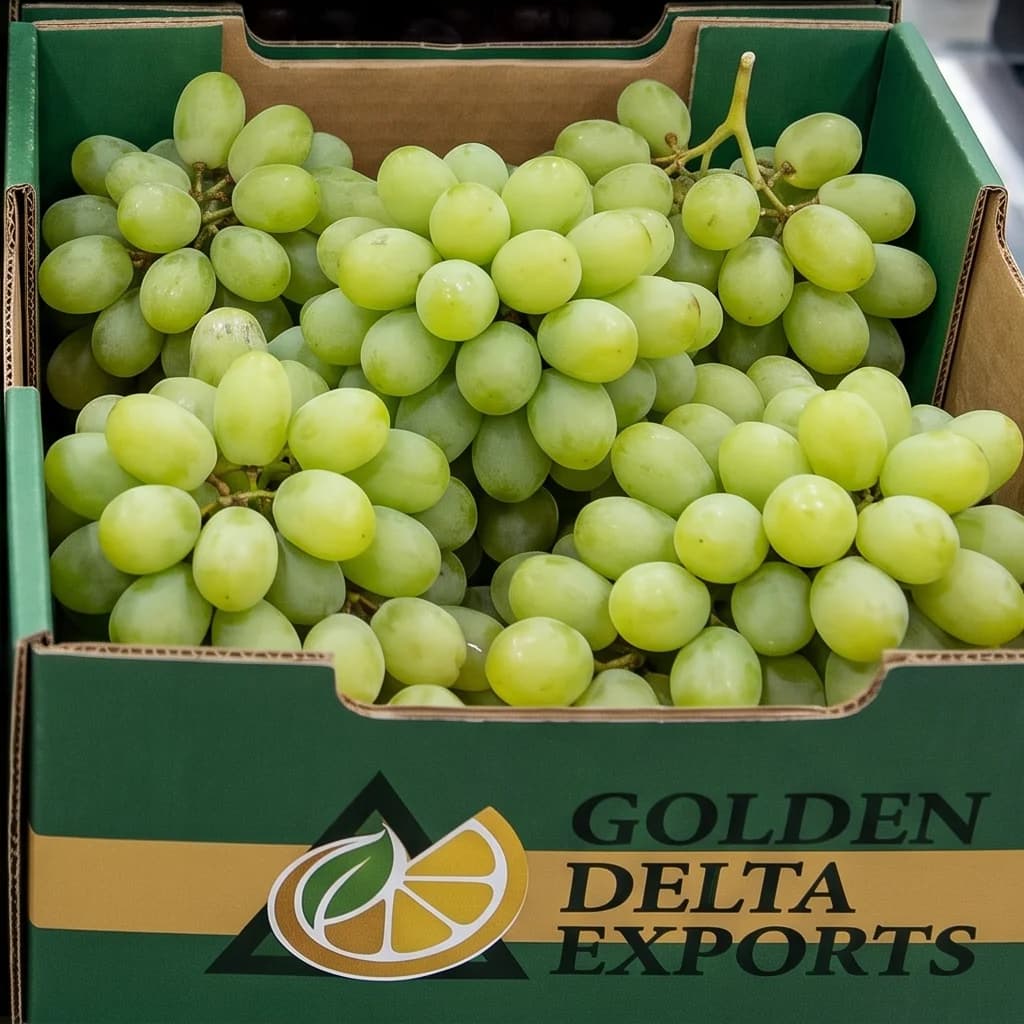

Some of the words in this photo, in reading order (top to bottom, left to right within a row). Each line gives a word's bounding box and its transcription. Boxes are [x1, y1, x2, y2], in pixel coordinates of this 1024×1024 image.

[570, 791, 993, 847] GOLDEN
[559, 861, 856, 914] DELTA
[548, 925, 977, 978] EXPORTS
